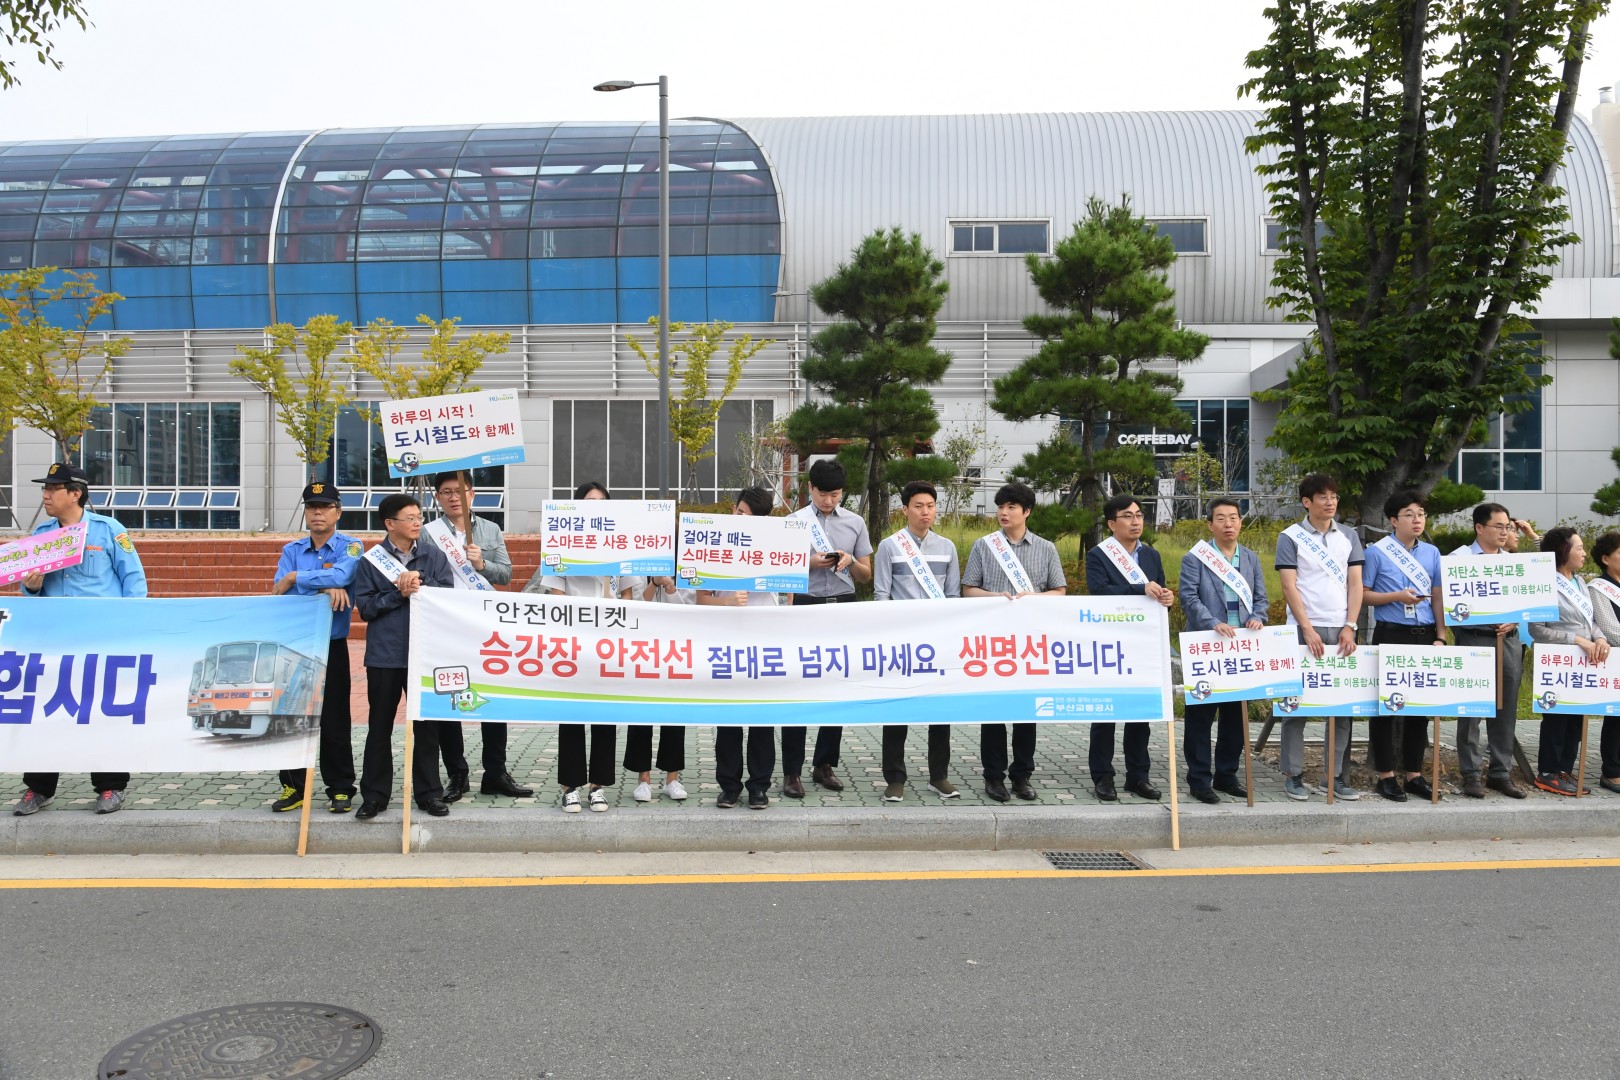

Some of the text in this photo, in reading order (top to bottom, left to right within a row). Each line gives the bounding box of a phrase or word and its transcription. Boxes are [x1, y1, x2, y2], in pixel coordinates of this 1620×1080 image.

[390, 409, 432, 425] 하루의
[438, 405, 465, 420] 시작
[394, 422, 515, 448] 도시철도와 함께!
[1118, 434, 1192, 445] COFFEEBAY
[547, 516, 616, 531] 걸어갈 때는
[546, 534, 672, 550] 스마트폰 사용 안하기
[684, 529, 752, 547] 걸어갈 때는
[1296, 532, 1328, 561] 안전하고
[682, 548, 807, 567] 스마트폰 사용 안하기
[1386, 543, 1418, 573] 안전하고
[1447, 563, 1525, 579] 저탄소 녹색교통
[1449, 580, 1552, 598] 도시철도를 이용합시다
[483, 599, 640, 630] 「안전에티켓」
[1079, 609, 1145, 623] Humetro
[479, 631, 1132, 680] 승강장 안전선 절대로 넘지 마세요. 생명선입니다.
[1188, 641, 1224, 656] 하루의
[1229, 639, 1252, 653] 시작
[1191, 657, 1295, 677] 도시철도와 함께!
[1385, 655, 1416, 669] 저탄소
[1421, 655, 1464, 670] 녹색교통
[1540, 653, 1573, 668] 하루의
[437, 672, 465, 687] 안전
[1385, 671, 1490, 688] 도시철도를 이용합시다
[1540, 671, 1609, 689] 도시철도와
[1055, 703, 1114, 712] 부산교통공사
